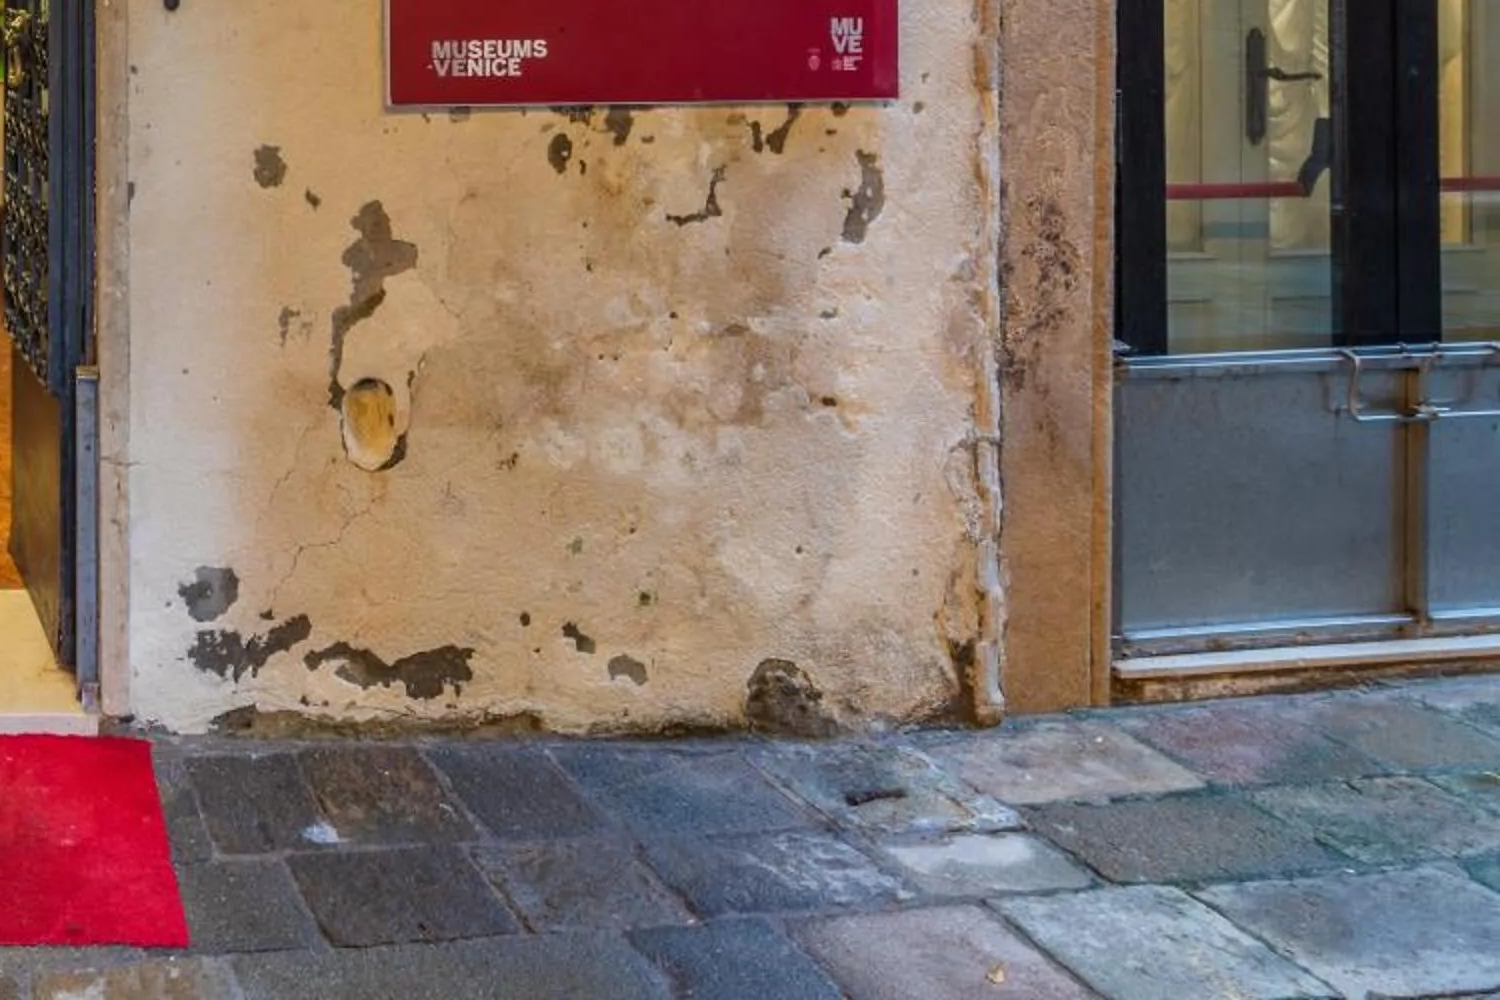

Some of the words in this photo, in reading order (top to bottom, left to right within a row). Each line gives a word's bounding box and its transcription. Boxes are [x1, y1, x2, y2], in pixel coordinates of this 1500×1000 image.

[830, 17, 863, 35] MU
[431, 39, 549, 59] MUSEUMS
[830, 35, 863, 53] VE
